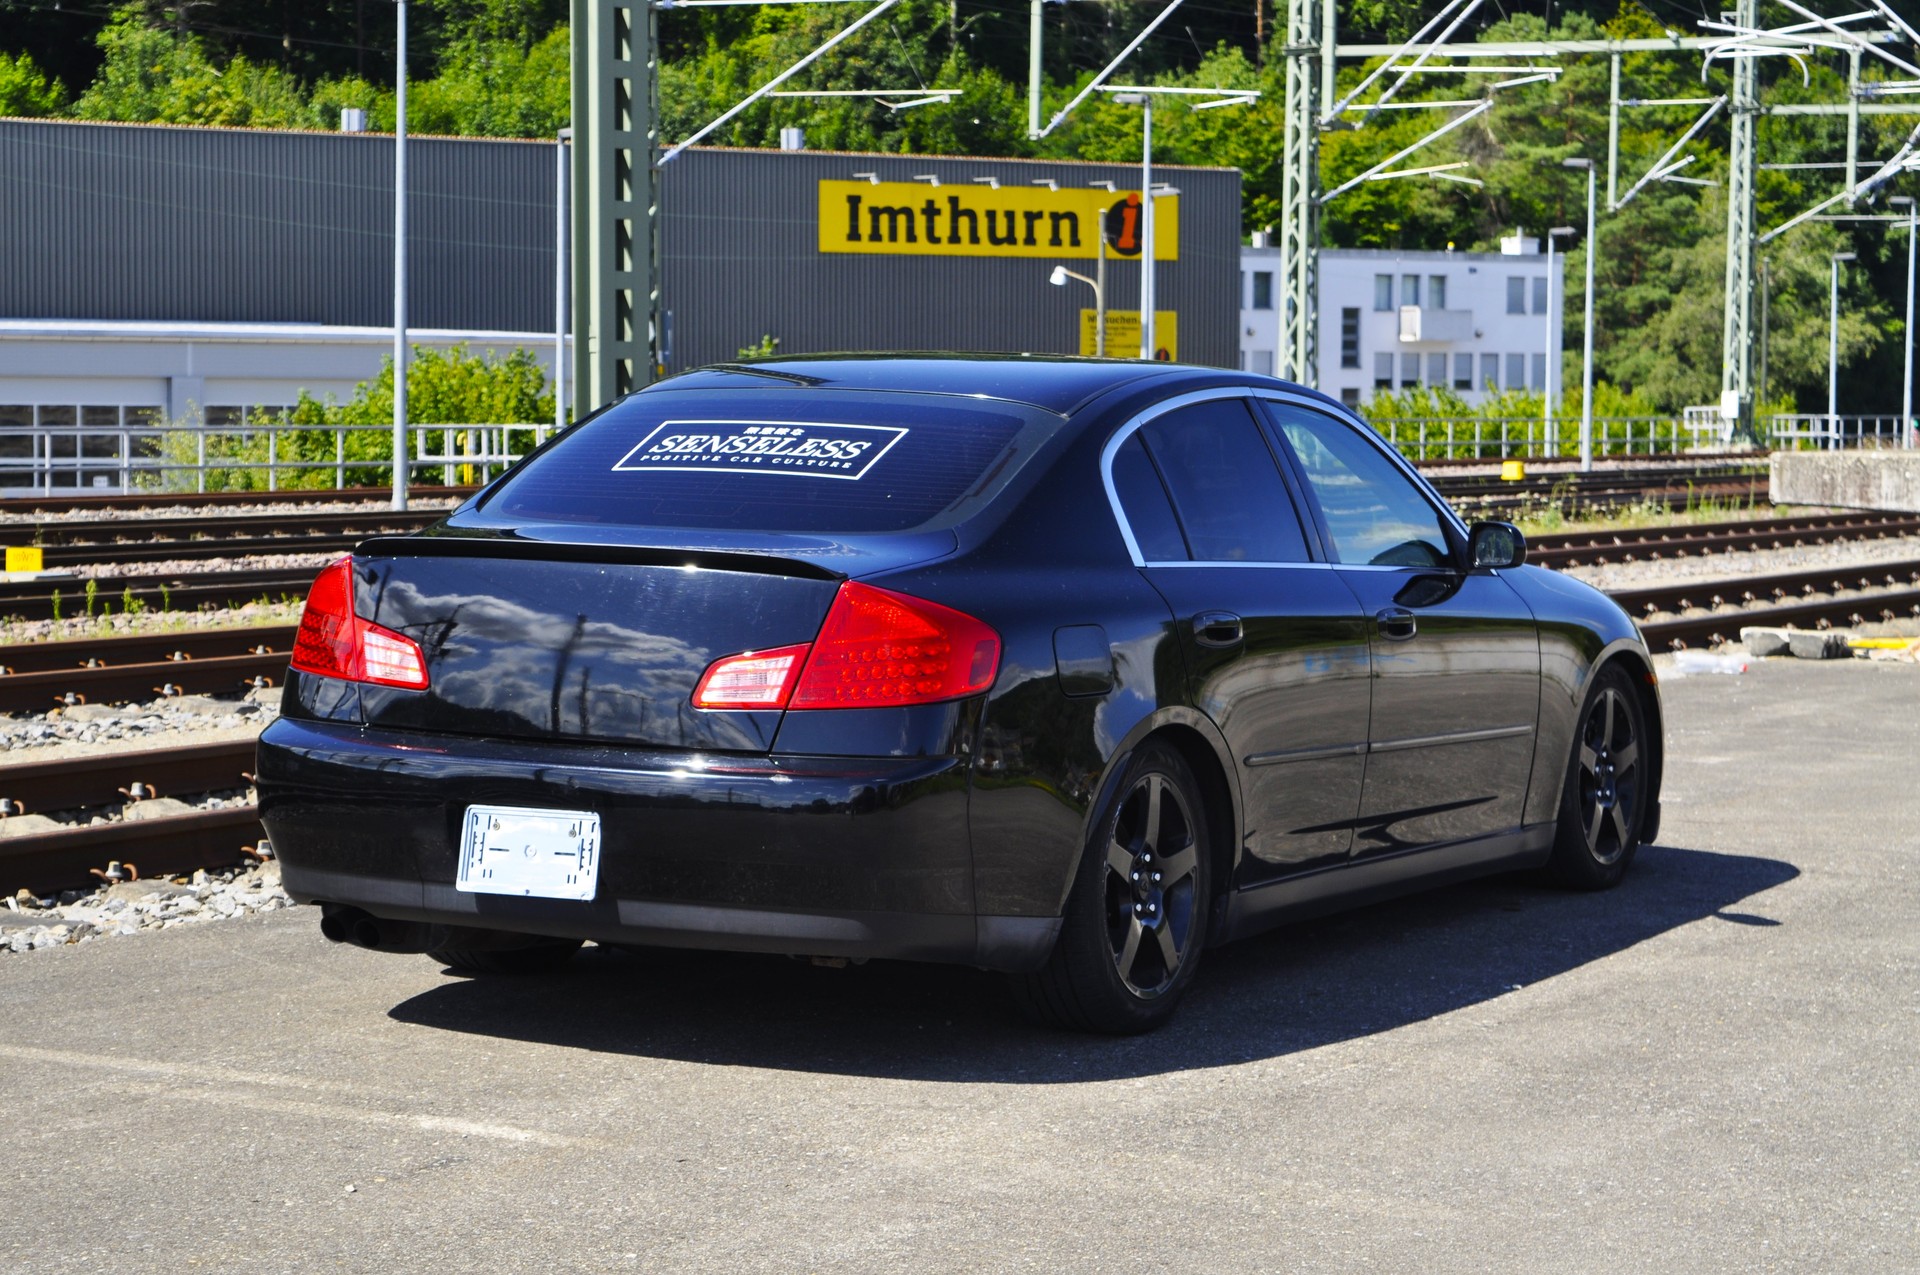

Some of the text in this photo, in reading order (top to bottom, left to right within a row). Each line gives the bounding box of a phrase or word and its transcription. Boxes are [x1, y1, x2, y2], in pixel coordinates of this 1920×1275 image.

[846, 195, 1081, 247] Imthurn
[648, 435, 872, 460] SENSELESS
[640, 455, 852, 469] POSITIVE CAR CULTURE
